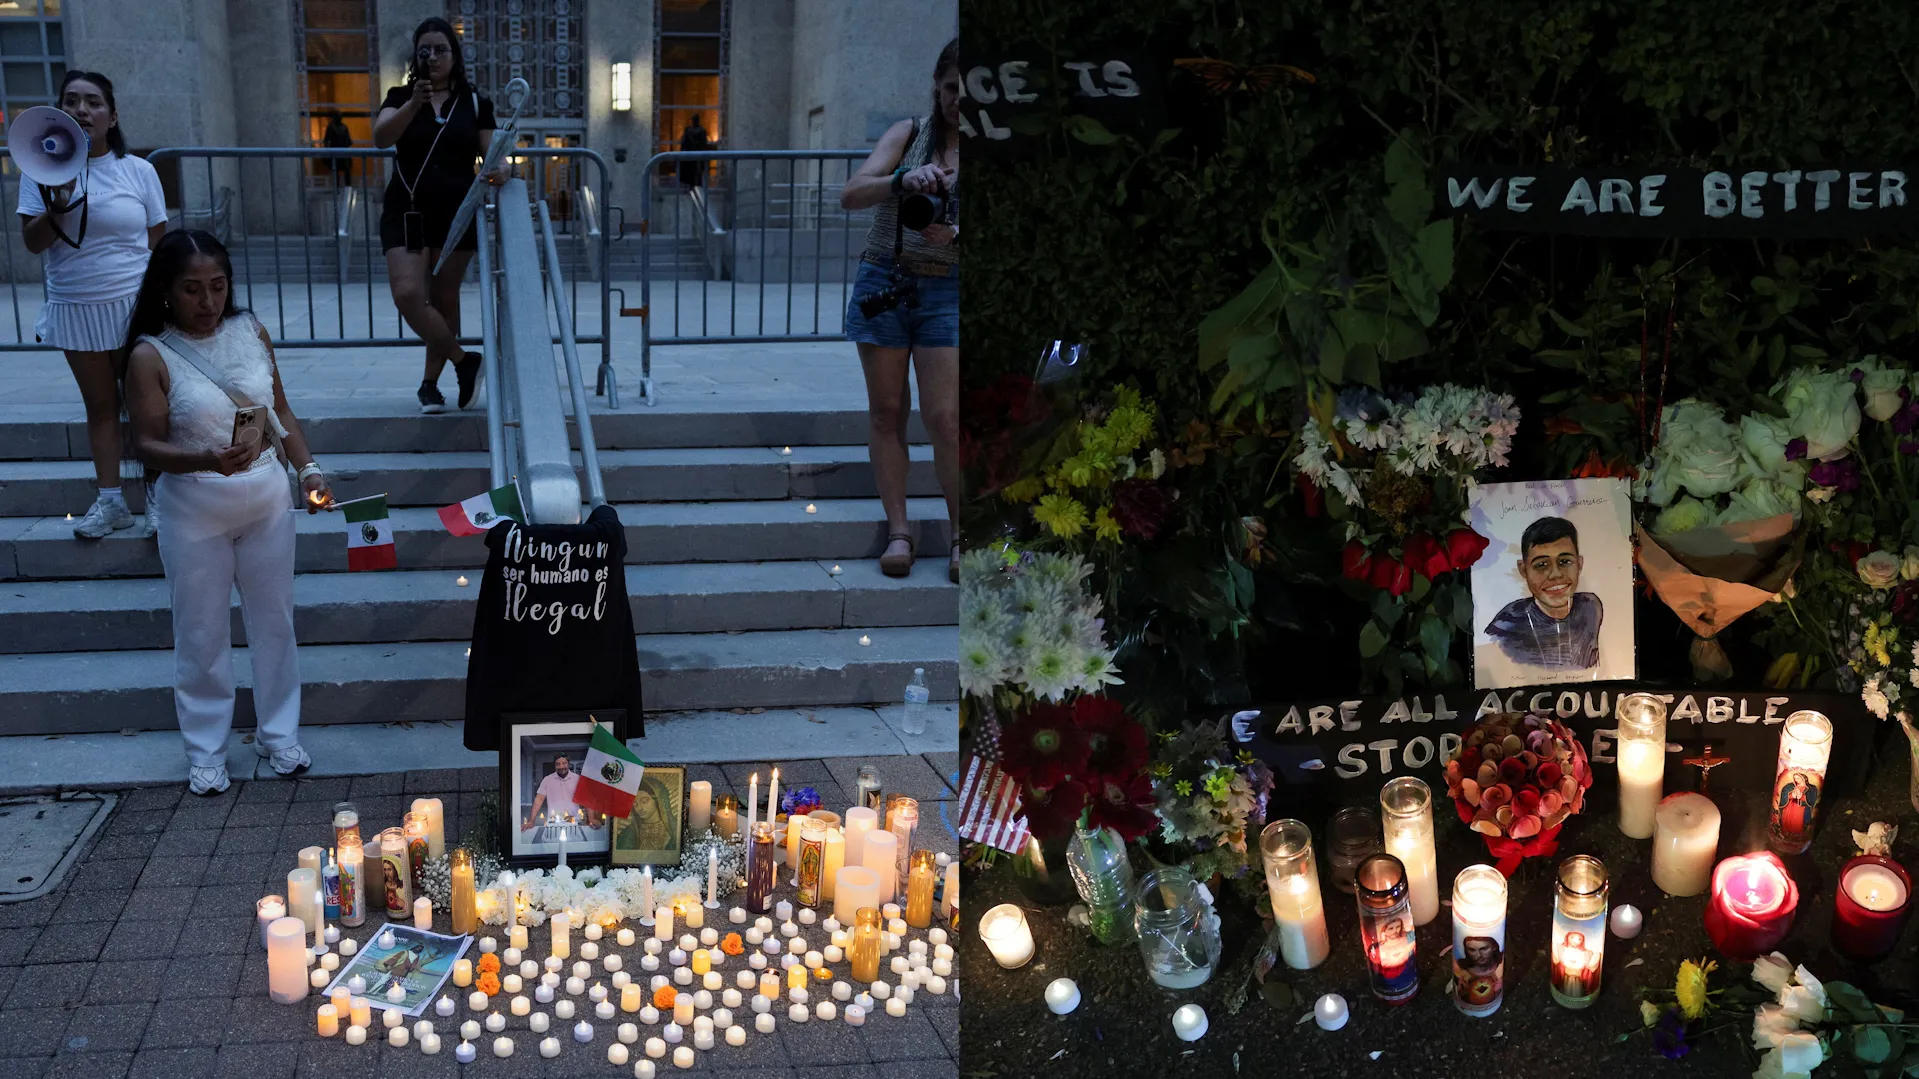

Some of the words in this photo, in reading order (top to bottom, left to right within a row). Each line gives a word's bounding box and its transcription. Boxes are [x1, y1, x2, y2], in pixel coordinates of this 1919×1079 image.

[1063, 60, 1141, 98] IS
[1448, 176, 1537, 212] WE
[1560, 174, 1667, 218] ARE
[1702, 169, 1909, 219] BETTER
[503, 522, 609, 573] Ningun
[503, 565, 525, 583] ser
[530, 563, 589, 584] humano
[595, 565, 609, 582] es
[503, 579, 607, 635] Ilegal
[1275, 700, 1363, 736] ARE
[1379, 693, 1459, 724] ALL
[1333, 732, 1463, 779] STOP
